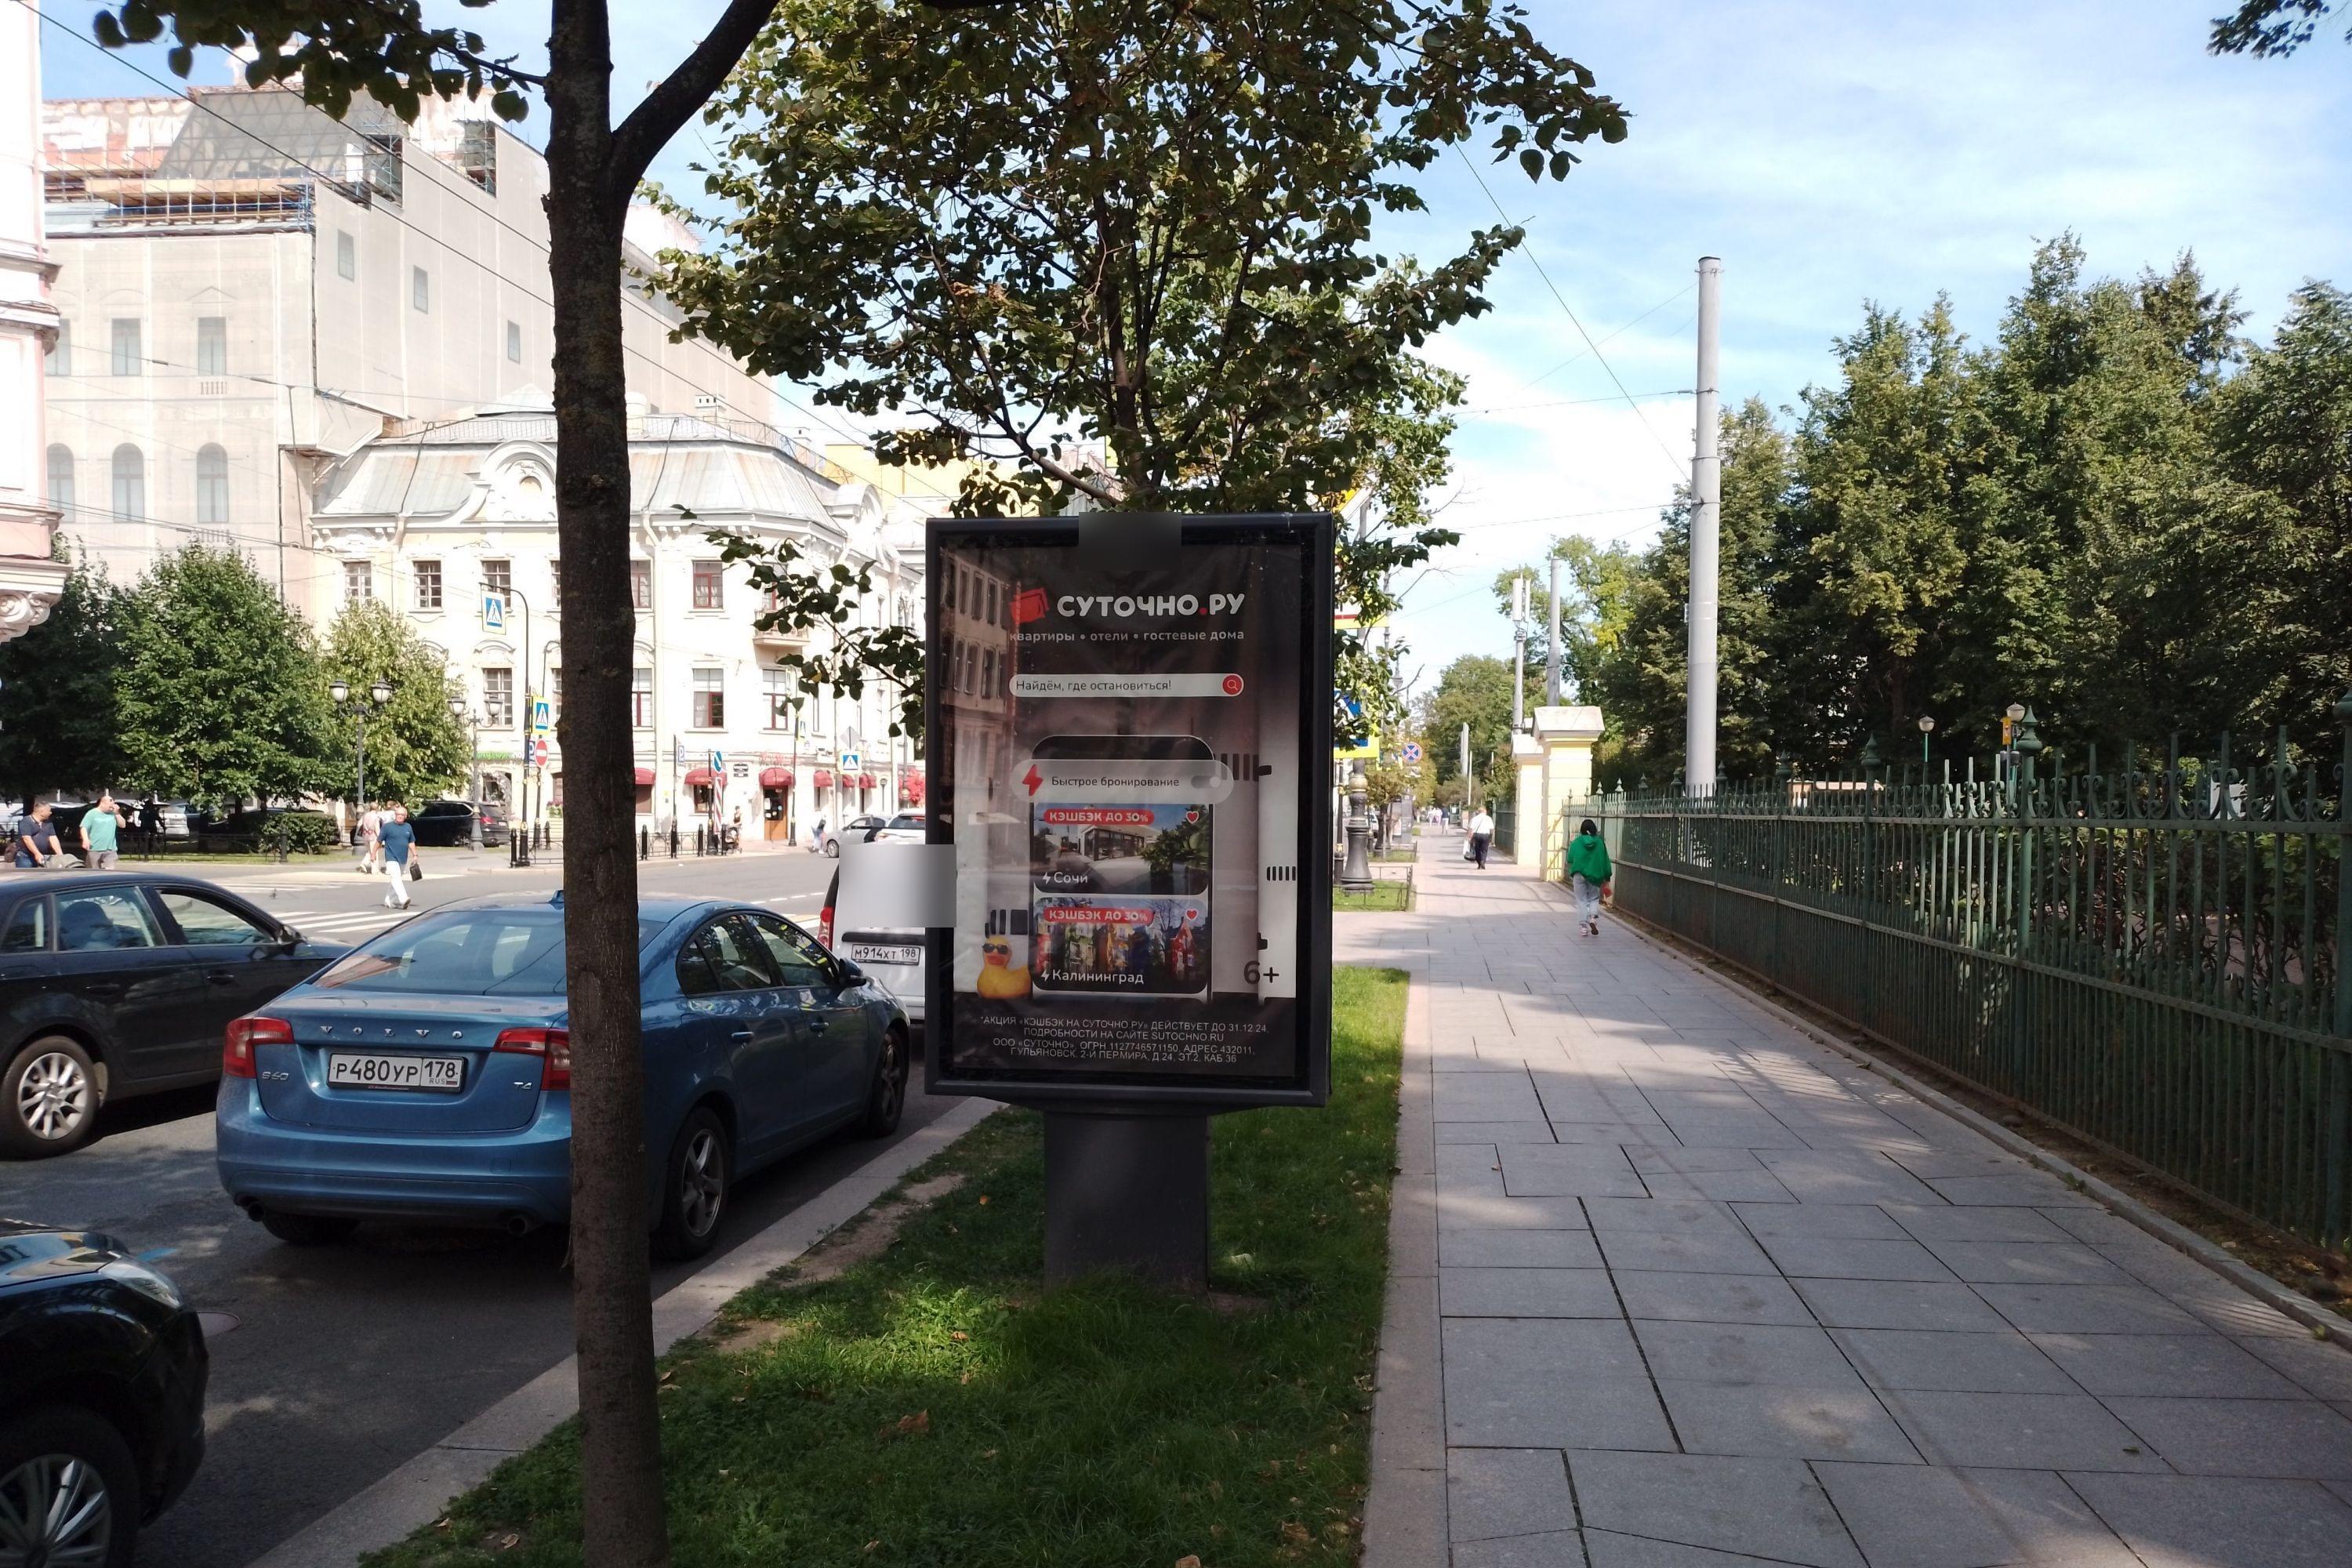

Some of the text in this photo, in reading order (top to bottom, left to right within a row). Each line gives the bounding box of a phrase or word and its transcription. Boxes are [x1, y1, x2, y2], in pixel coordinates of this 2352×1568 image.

[1057, 593, 1245, 617] СУТОЧНО.РУ
[1009, 631, 1244, 643] квартиры отели гостевые дома
[1016, 680, 1172, 691] Найдём, где остановиться!
[1051, 776, 1179, 788] Быстрое бронирование
[1049, 811, 1149, 822] КЭШБЭК ДО 30%
[1054, 871, 1088, 884] Сочи
[1049, 909, 1148, 921] КЭШБЭК ДО 30%
[899, 949, 916, 958] 198
[1052, 969, 1144, 985] Калининград
[1243, 960, 1279, 985] 6+
[1066, 1019, 1080, 1028] НА
[1151, 1021, 1209, 1031] ДЕЙСТВУЕТ
[1211, 1022, 1225, 1032] ДО
[1024, 1028, 1098, 1038] ПОДРОБНОСТИ
[1100, 1030, 1114, 1039] НА
[1116, 1030, 1149, 1040] САЙТЕ
[993, 1037, 1015, 1047] ООО
[1080, 1041, 1106, 1051] ОГРН
[336, 1058, 456, 1083] Р480УР 178
